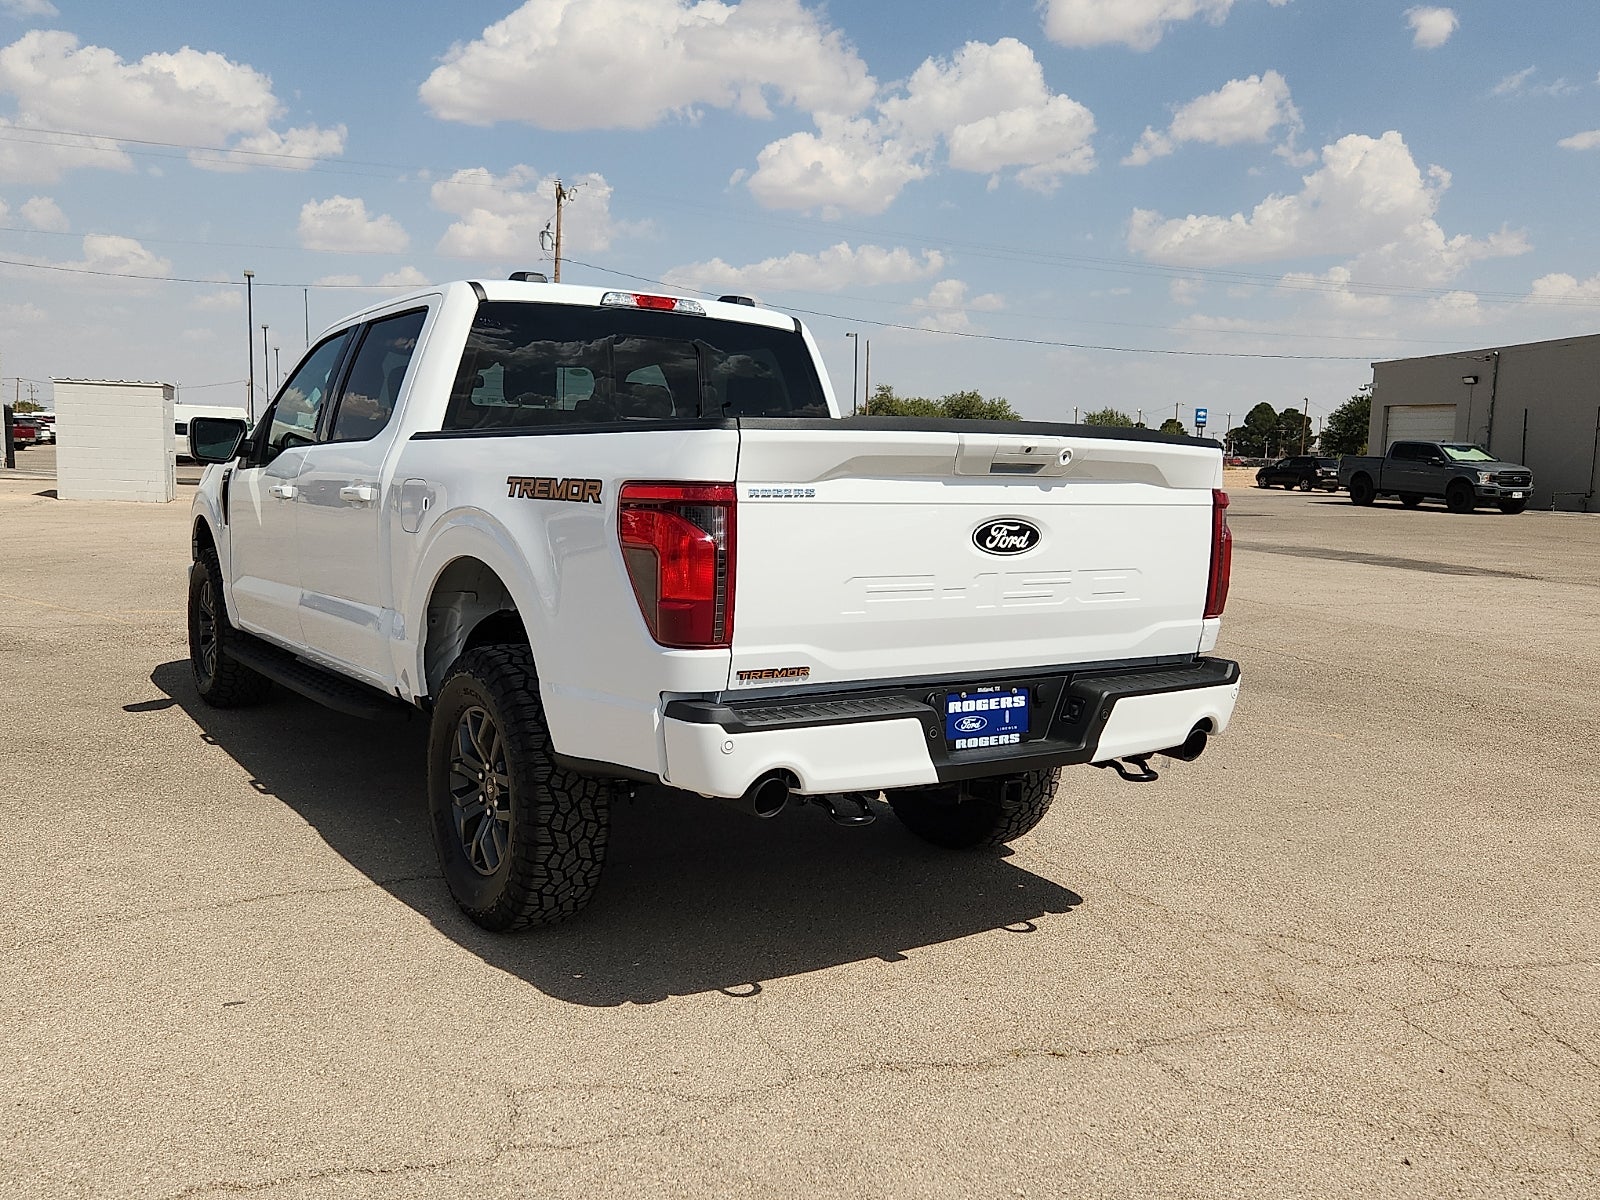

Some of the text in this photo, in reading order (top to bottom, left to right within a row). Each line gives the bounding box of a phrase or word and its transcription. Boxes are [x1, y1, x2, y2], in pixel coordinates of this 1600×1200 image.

[506, 476, 602, 504] TREMOR
[985, 523, 1030, 549] Ford
[737, 666, 810, 681] TREMOR
[948, 695, 1026, 713] ROGERS
[960, 718, 982, 730] Ford
[955, 733, 1020, 749] ROGERS
